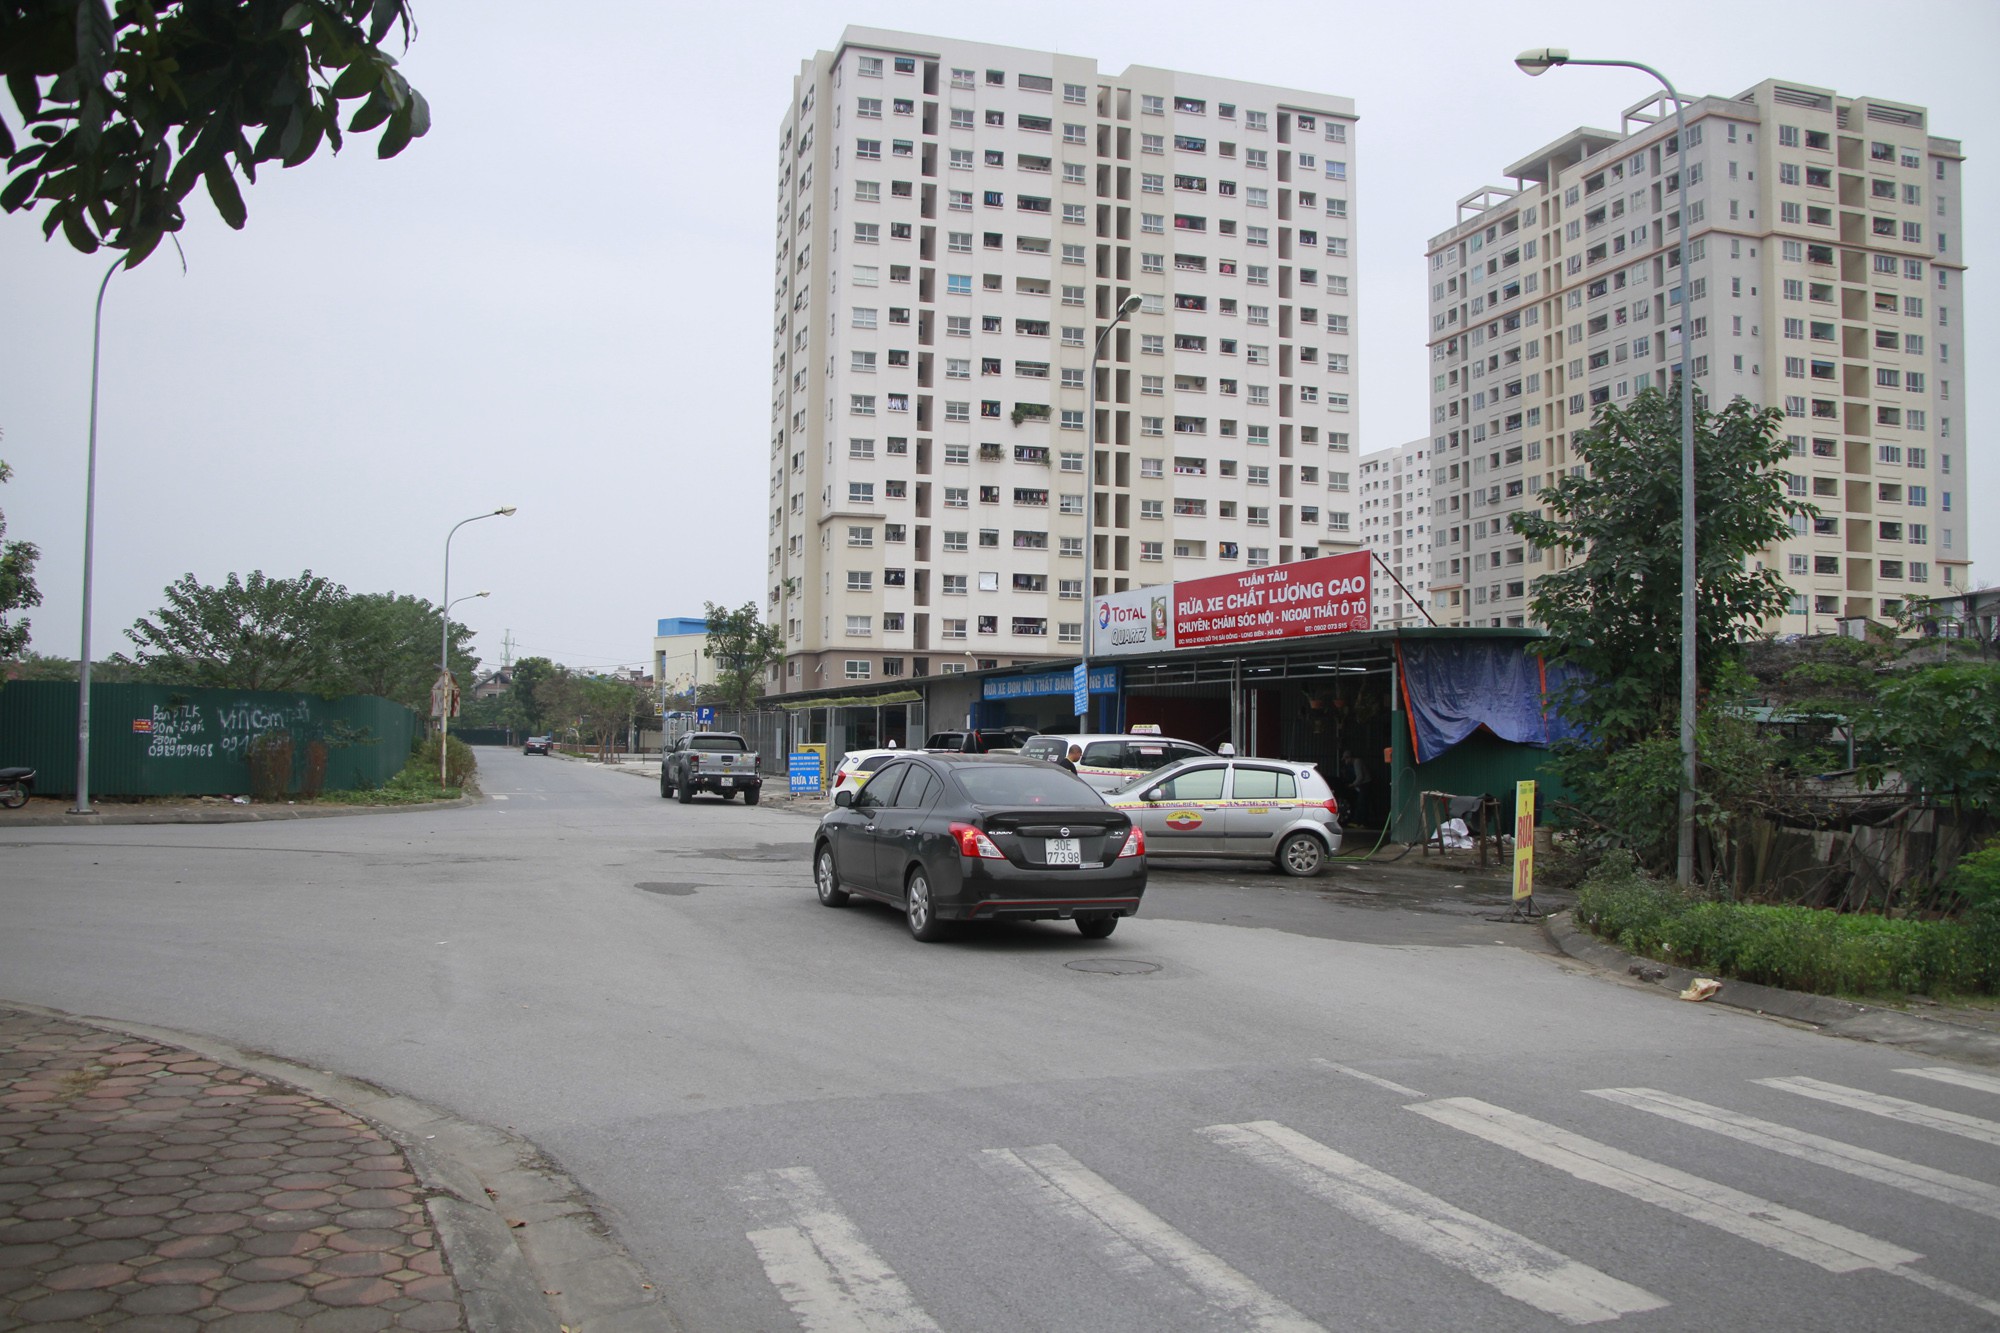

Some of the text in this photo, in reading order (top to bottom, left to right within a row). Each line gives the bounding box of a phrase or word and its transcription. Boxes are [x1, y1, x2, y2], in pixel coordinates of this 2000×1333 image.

[1267, 570, 1288, 583] TÀU
[1178, 576, 1366, 616] RỬA XE CHẤT LƯỢNG CAO
[1112, 606, 1147, 622] TOTAL
[1177, 617, 1211, 634] CHUYÊN:
[1211, 615, 1236, 630] CHĂM
[1237, 611, 1256, 627] SÓC
[1257, 609, 1274, 627] NỘI
[1281, 607, 1311, 623] NGOẠI
[1313, 600, 1339, 619] THẤT
[1341, 599, 1350, 616] Ô
[1352, 597, 1367, 614] TÔ
[1111, 627, 1147, 646] QUARTZ
[998, 682, 1006, 695] XE
[1089, 675, 1100, 689] NG
[1104, 674, 1115, 688] XE
[703, 708, 710, 718] P
[808, 775, 819, 785] XE
[1054, 840, 1072, 851] 30E
[1047, 851, 1080, 863] 773.98
[1519, 858, 1529, 893] XE
